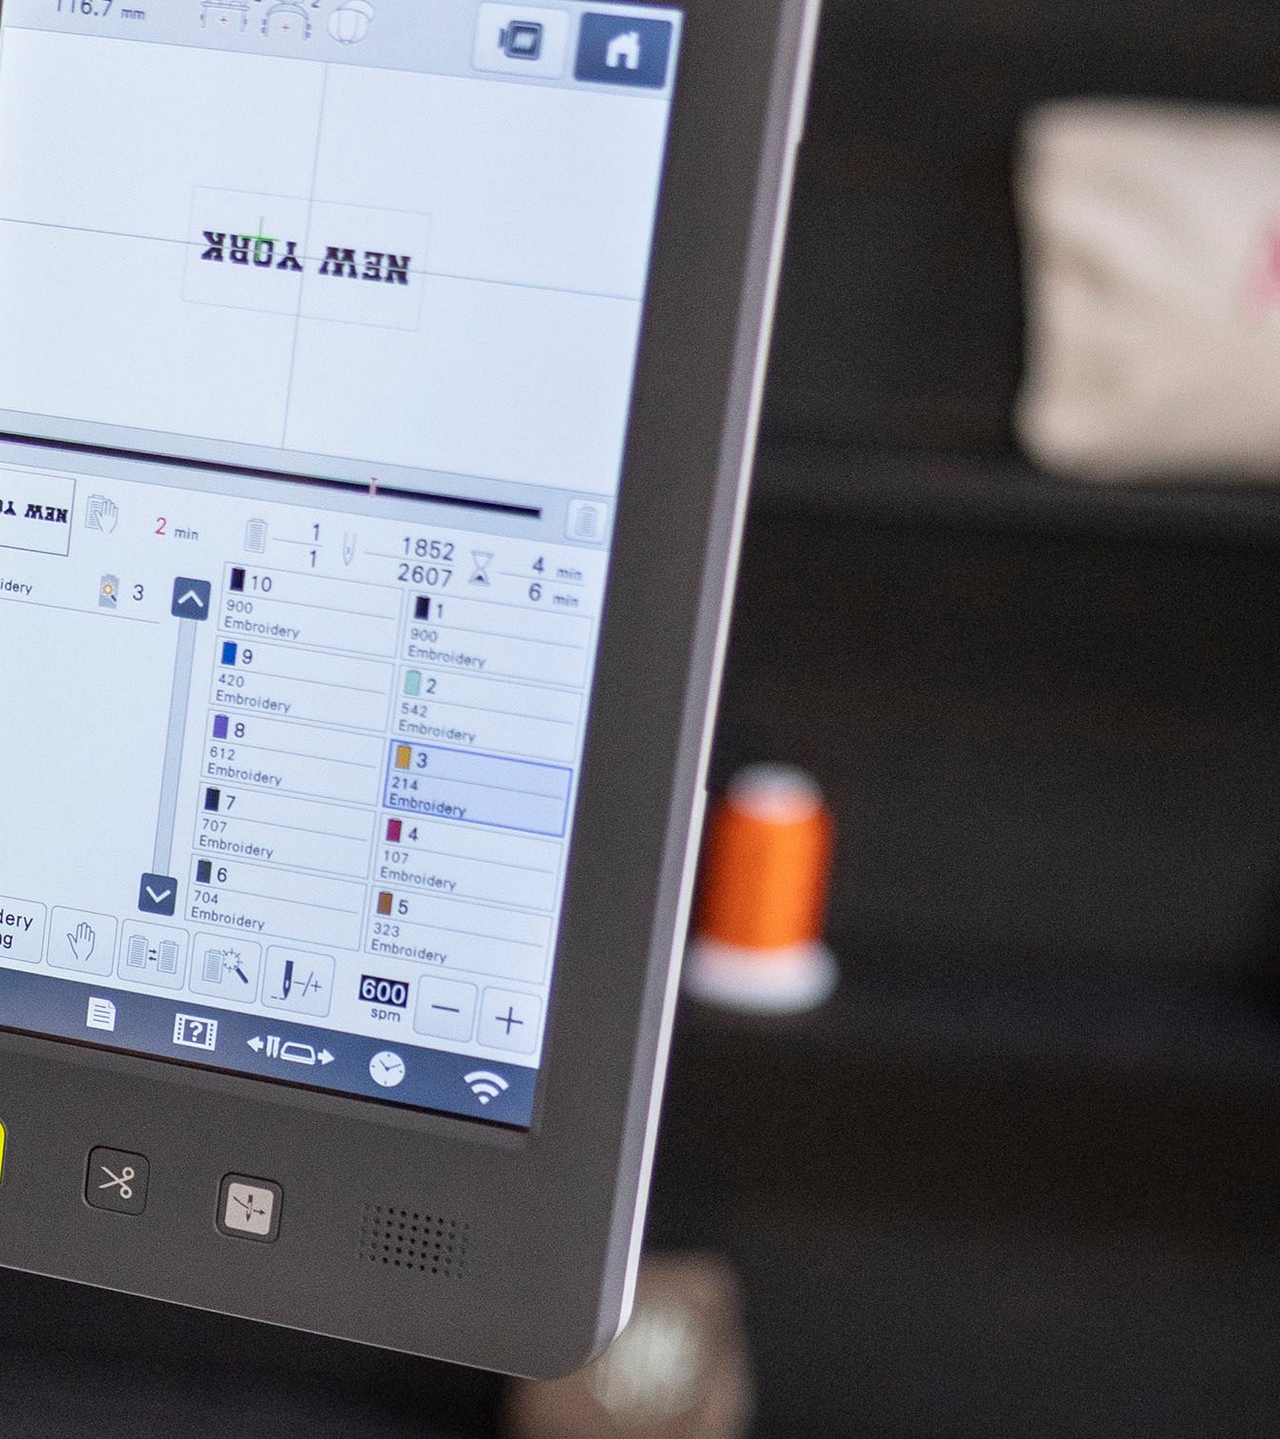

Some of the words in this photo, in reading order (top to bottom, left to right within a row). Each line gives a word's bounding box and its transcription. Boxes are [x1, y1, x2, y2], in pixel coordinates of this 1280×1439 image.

[121, 8, 146, 20] mm
[201, 230, 304, 273] YORK
[318, 245, 412, 286] NEW
[23, 503, 69, 524] NEW
[155, 517, 167, 536] 2
[174, 527, 199, 541] min
[403, 537, 455, 561] 1852
[397, 563, 453, 588] 2607
[532, 556, 544, 573] 4
[556, 566, 583, 582] min
[251, 575, 273, 592] 10
[133, 584, 144, 601] 3
[528, 583, 541, 601] 6
[552, 593, 579, 608] min
[226, 599, 253, 614] 900
[224, 616, 301, 640] Embroidery
[410, 628, 438, 643] 900
[242, 649, 253, 666] 9
[408, 644, 486, 670] Embroidery
[218, 674, 245, 689] 420
[426, 679, 437, 694] 2
[216, 689, 292, 714] Embroidery
[234, 722, 246, 739] 8
[398, 719, 477, 744] Embroidery
[209, 746, 236, 761] 612
[416, 752, 428, 769] 3
[207, 763, 283, 787] Embroidery
[392, 776, 419, 791] 214
[225, 795, 237, 811] 7
[389, 793, 466, 818] Embroidery
[202, 819, 227, 833] 707
[407, 827, 419, 842] 4
[199, 835, 274, 859] Embroidery
[383, 850, 409, 864] 107
[217, 867, 228, 883] 6
[380, 866, 457, 891] Embroidery
[194, 890, 219, 905] 704
[397, 899, 409, 915] 5
[191, 907, 266, 931] Embroidery
[373, 922, 400, 938] 323
[371, 939, 447, 964] Embroidery
[361, 978, 407, 1005] 600
[371, 1008, 401, 1023] spm
